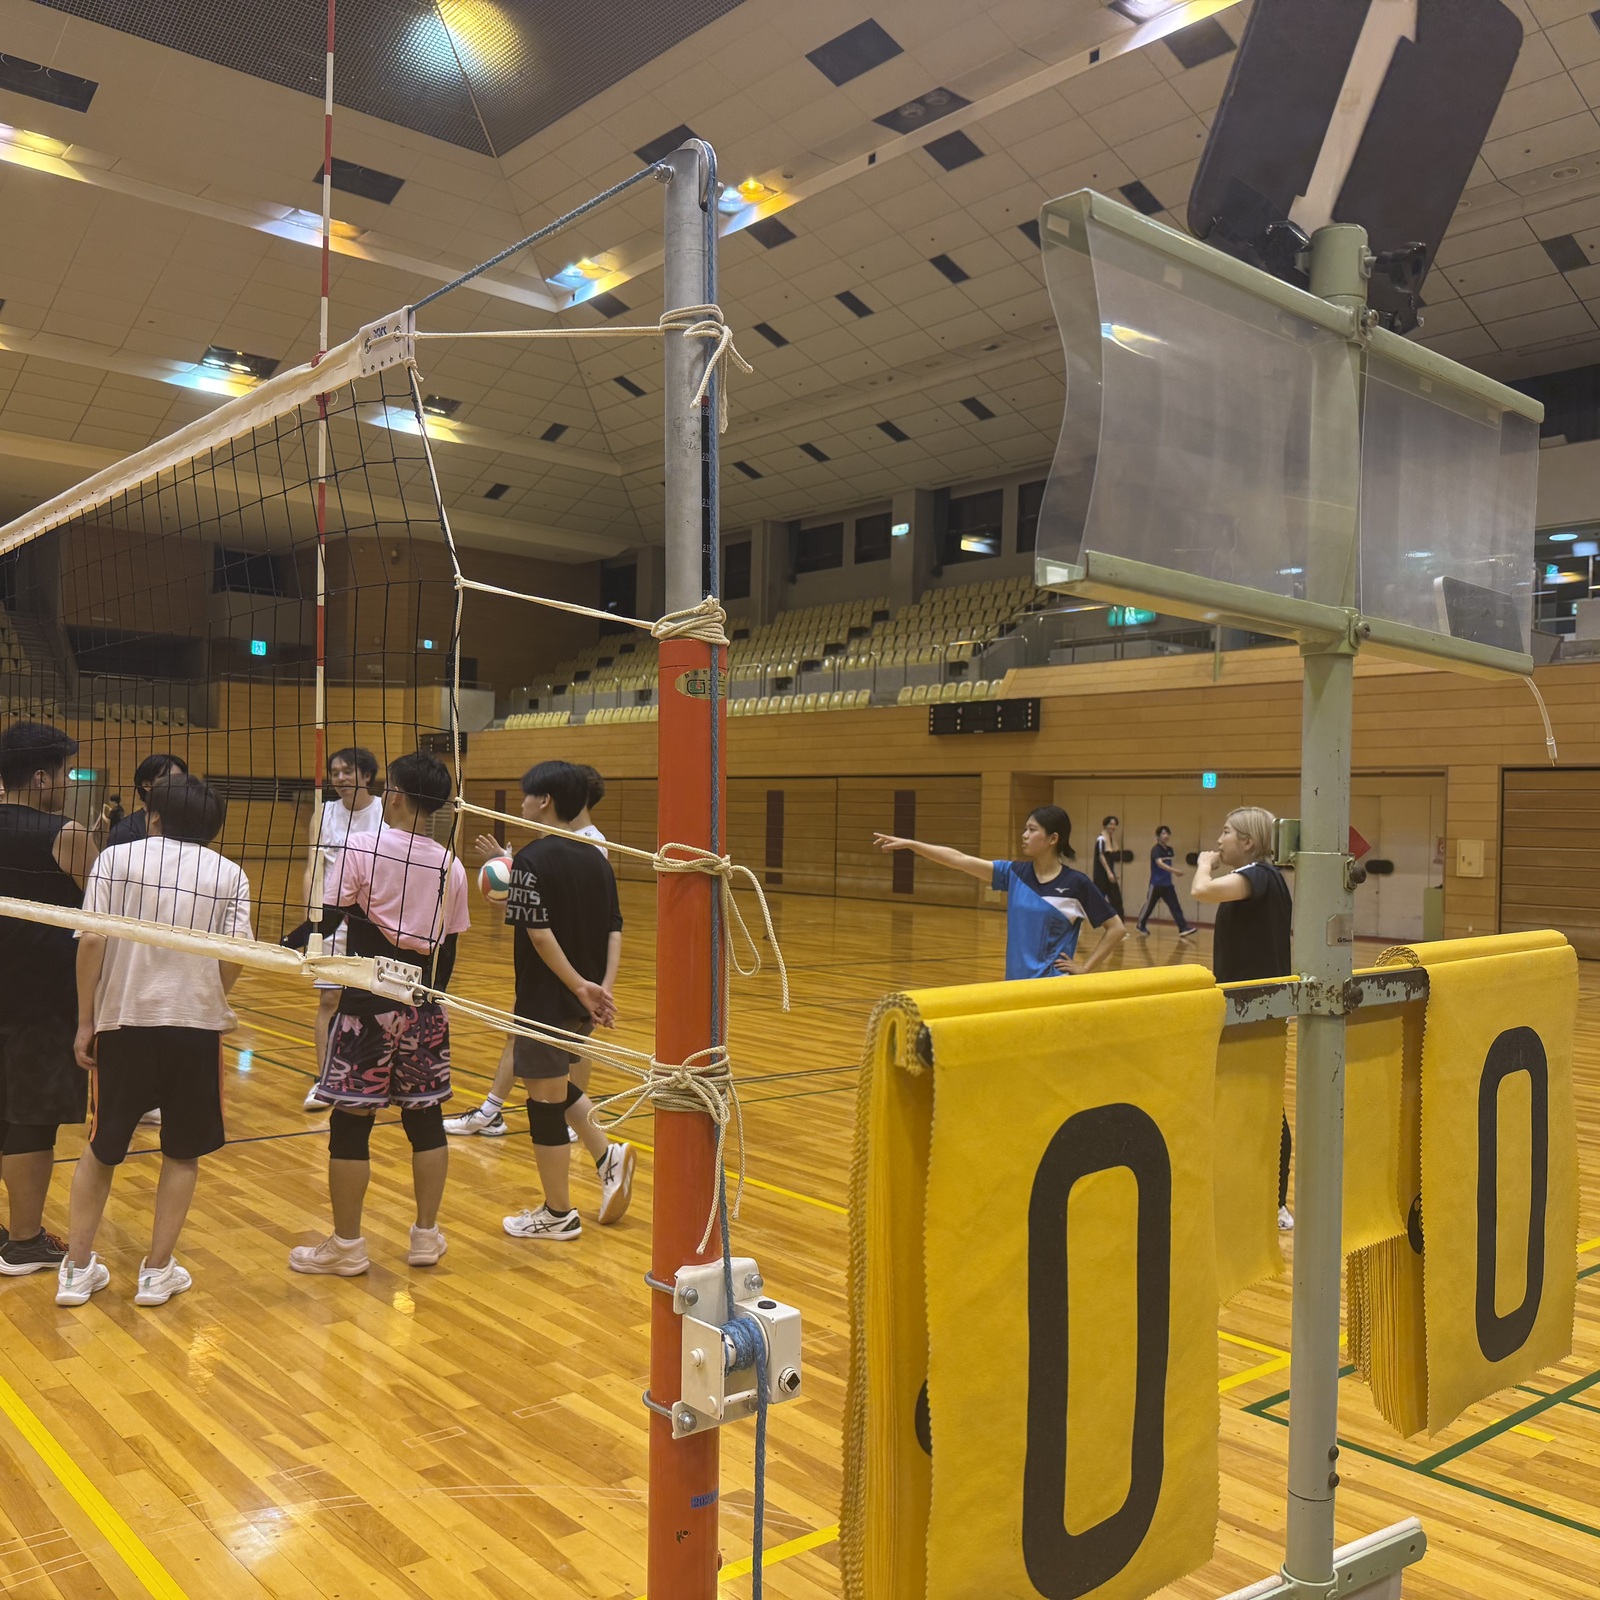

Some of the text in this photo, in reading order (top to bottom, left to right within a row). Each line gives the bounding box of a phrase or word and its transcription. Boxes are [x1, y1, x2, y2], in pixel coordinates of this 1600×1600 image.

[505, 905, 550, 923] STYLE
[1022, 1103, 1172, 1600] 0
[1475, 1026, 1549, 1363] 0
